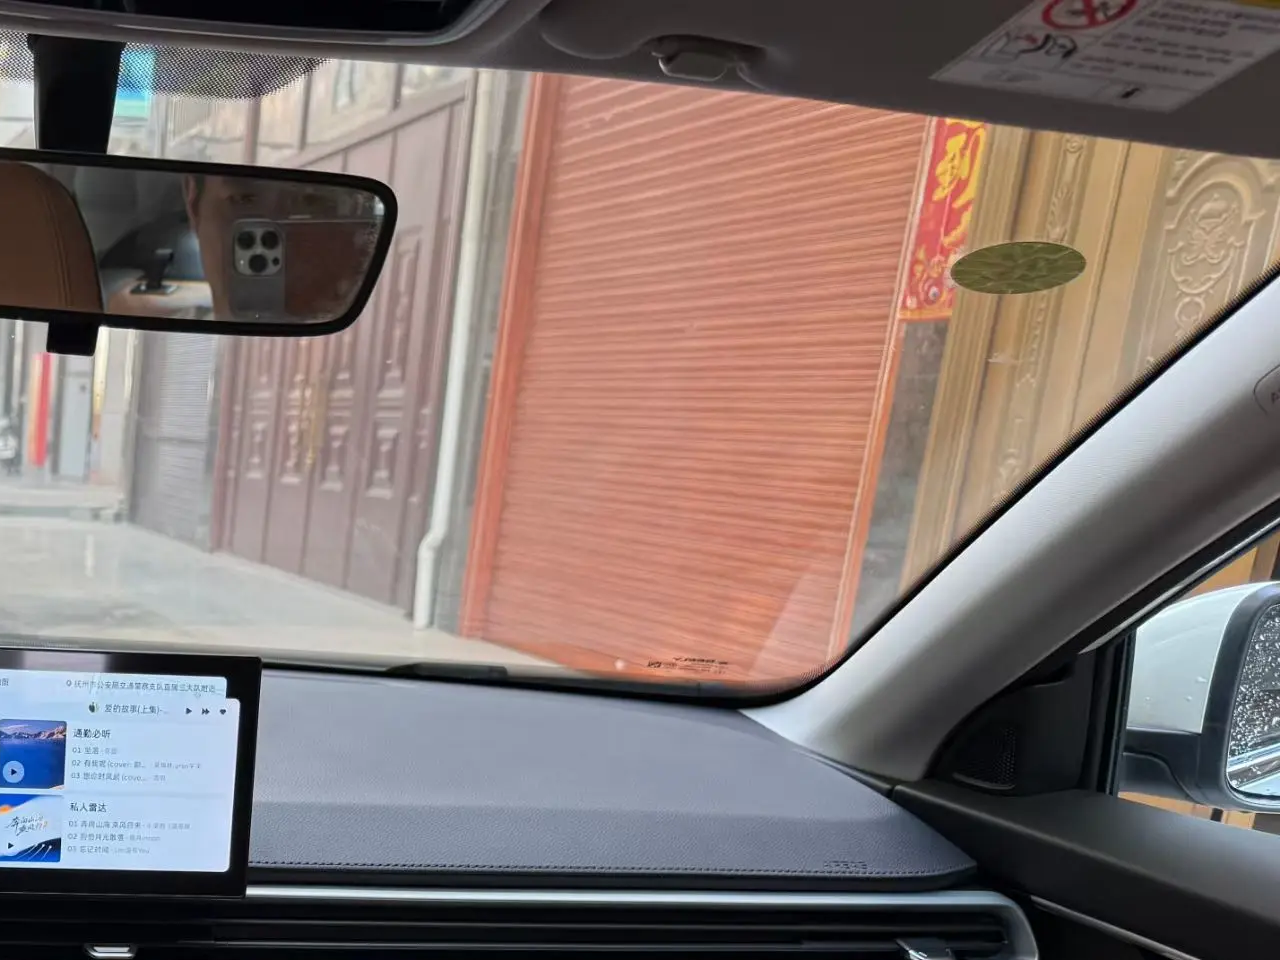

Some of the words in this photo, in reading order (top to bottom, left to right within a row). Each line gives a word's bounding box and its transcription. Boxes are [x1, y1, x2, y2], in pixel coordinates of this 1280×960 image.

[73, 728, 111, 739] 通勤必听
[70, 802, 107, 813] 私人雷达
